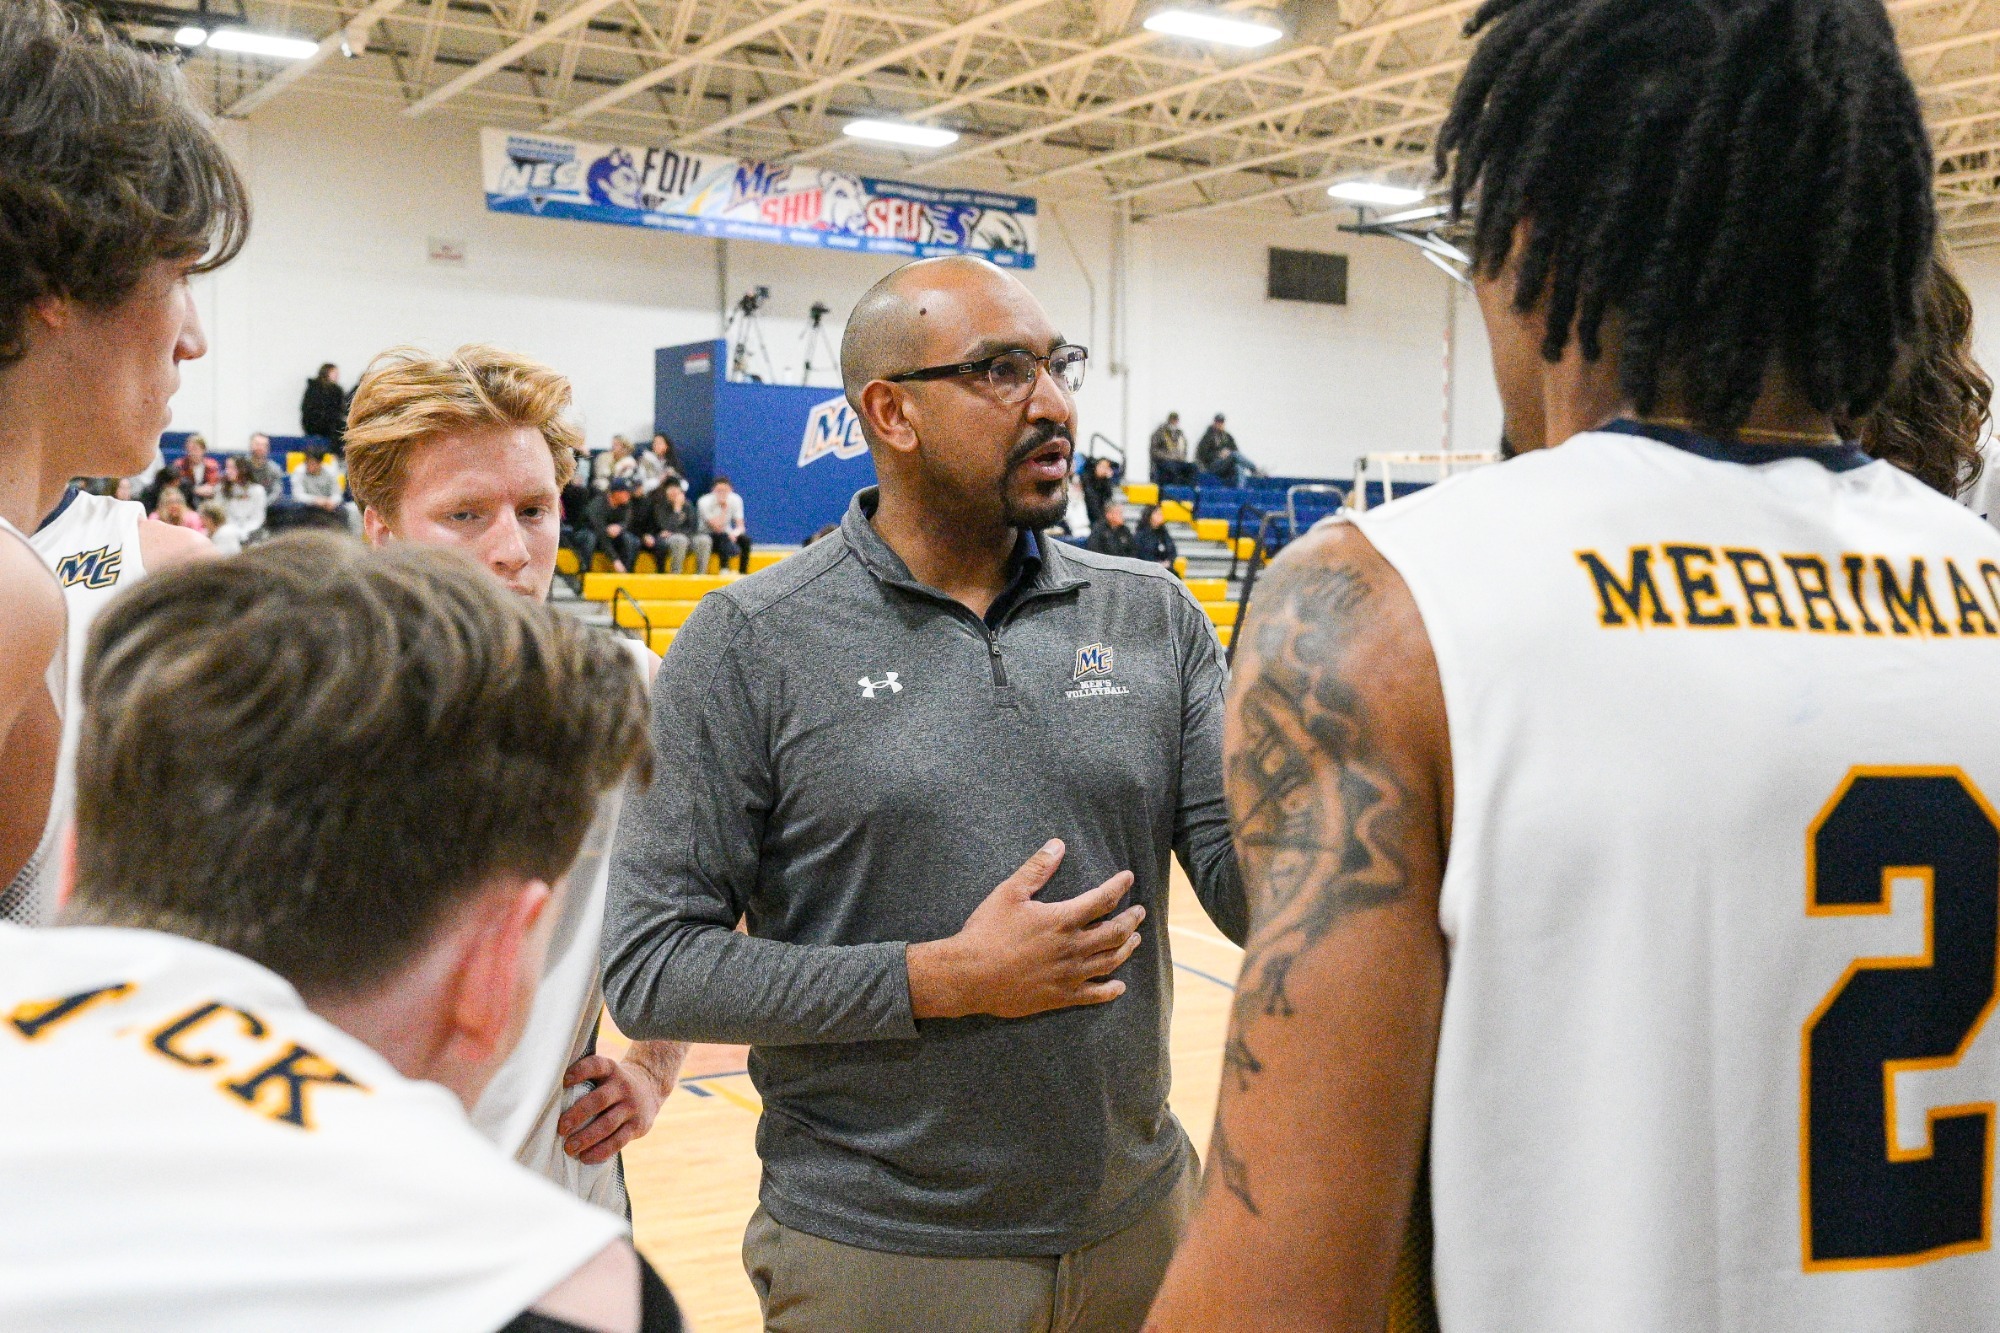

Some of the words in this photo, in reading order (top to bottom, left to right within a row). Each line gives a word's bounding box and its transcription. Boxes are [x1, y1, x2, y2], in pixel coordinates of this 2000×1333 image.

[762, 187, 824, 227] SHU
[56, 543, 123, 589] MC
[1074, 642, 1113, 680] MC
[1065, 686, 1130, 698] VOLLEYBALL
[1079, 679, 1112, 689] MEN'S
